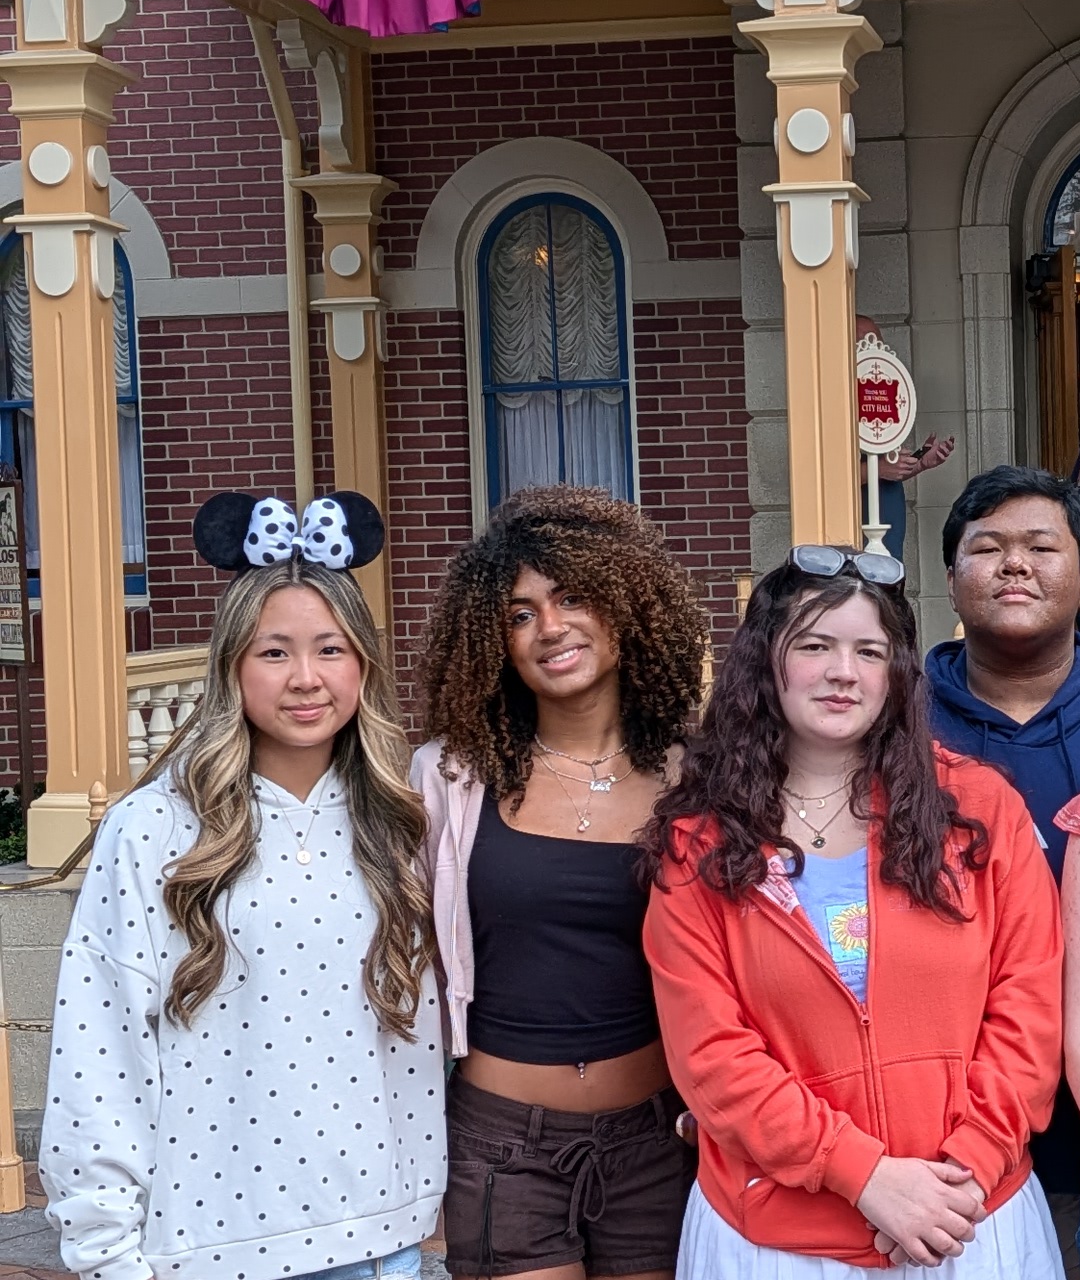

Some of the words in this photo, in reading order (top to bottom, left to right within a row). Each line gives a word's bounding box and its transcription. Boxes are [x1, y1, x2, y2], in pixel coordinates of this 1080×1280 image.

[861, 403, 875, 412] CITY
[877, 403, 892, 413] HALL
[0, 549, 19, 563] OST
